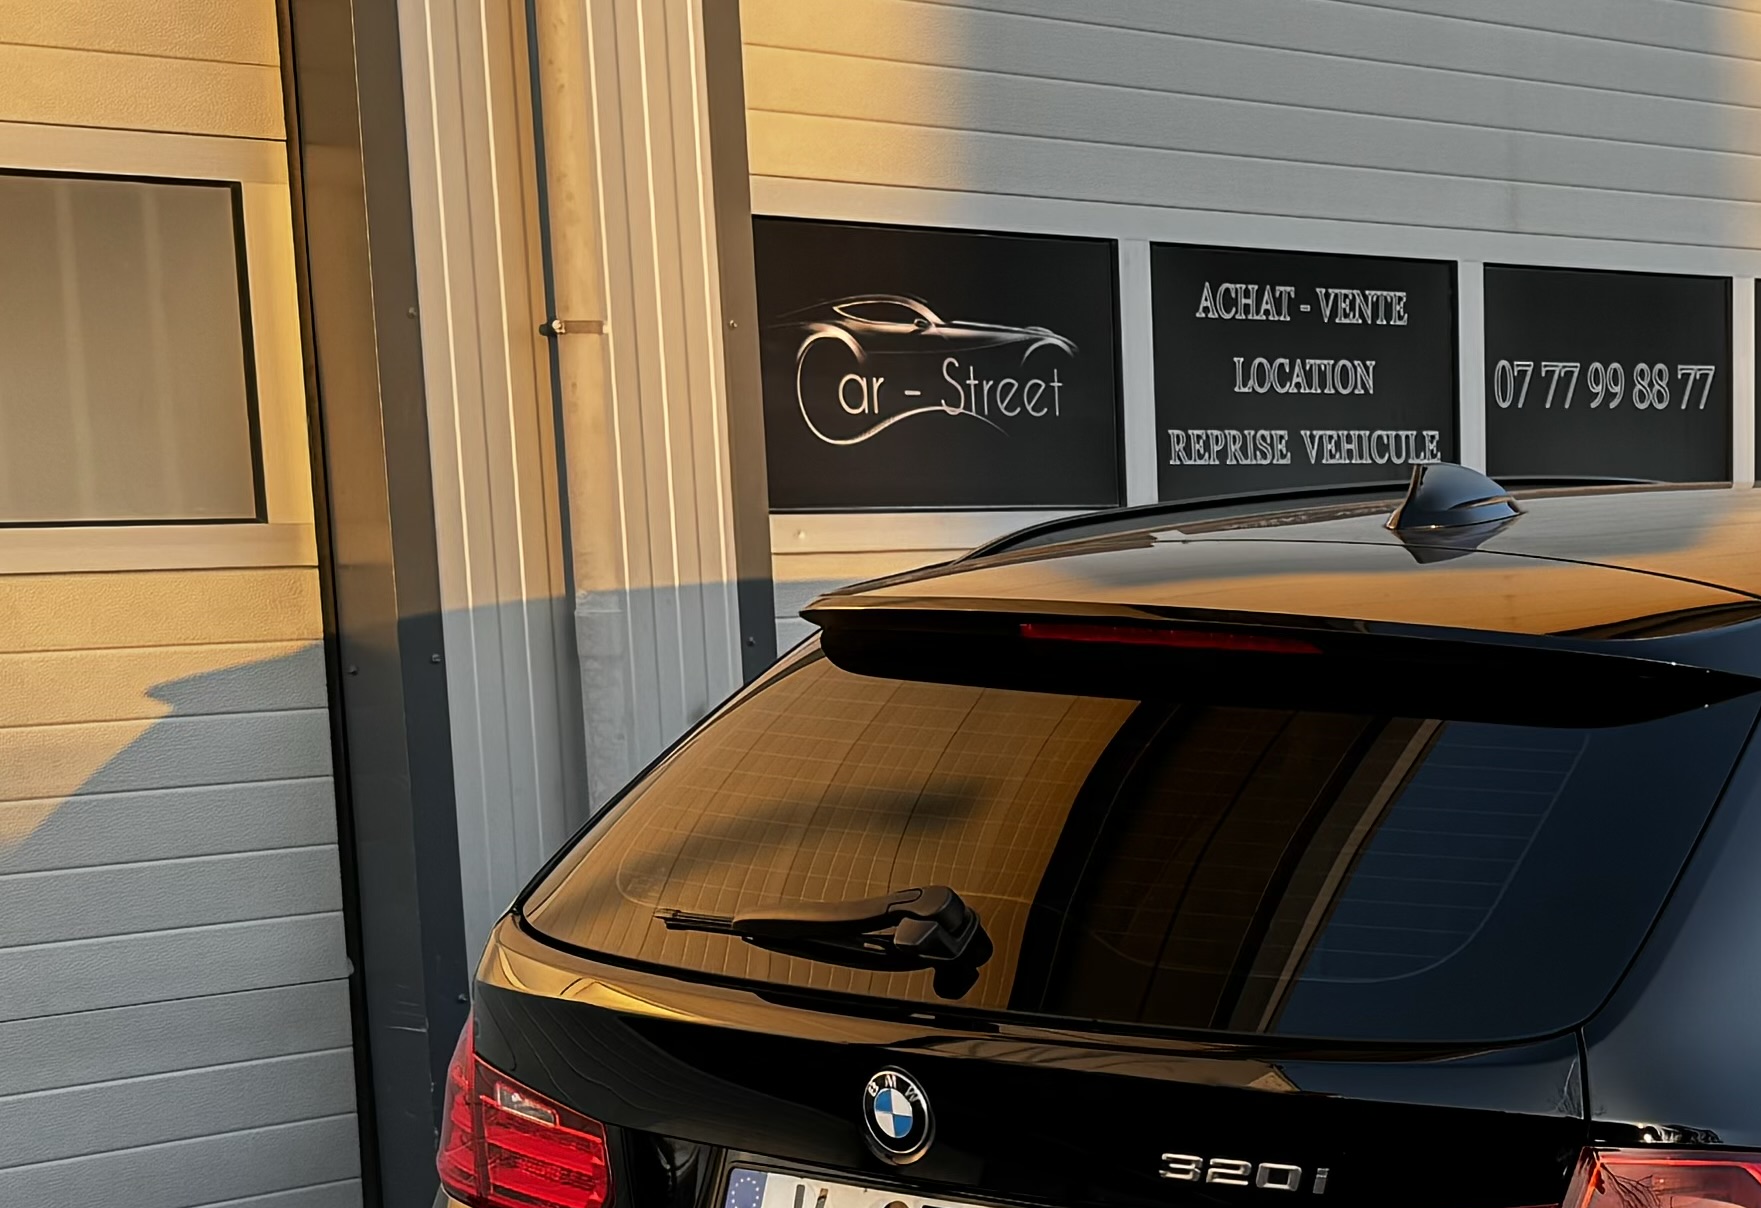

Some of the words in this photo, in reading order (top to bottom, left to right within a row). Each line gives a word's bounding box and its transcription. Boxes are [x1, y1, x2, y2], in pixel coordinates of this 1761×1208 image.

[1195, 281, 1295, 323] ACHAT
[1318, 287, 1408, 326] VENTE
[940, 357, 1063, 418] Street
[1233, 356, 1376, 395] LOCATION
[1494, 359, 1534, 409] 07
[1541, 361, 1581, 409] 77
[1587, 361, 1625, 409] 99
[1632, 362, 1670, 410] 88
[1677, 364, 1716, 410] 77
[1168, 428, 1291, 467] REPRISE
[1300, 429, 1442, 466] VEHICULE
[867, 1074, 921, 1103] BMW
[1158, 1152, 1330, 1195] 320i
